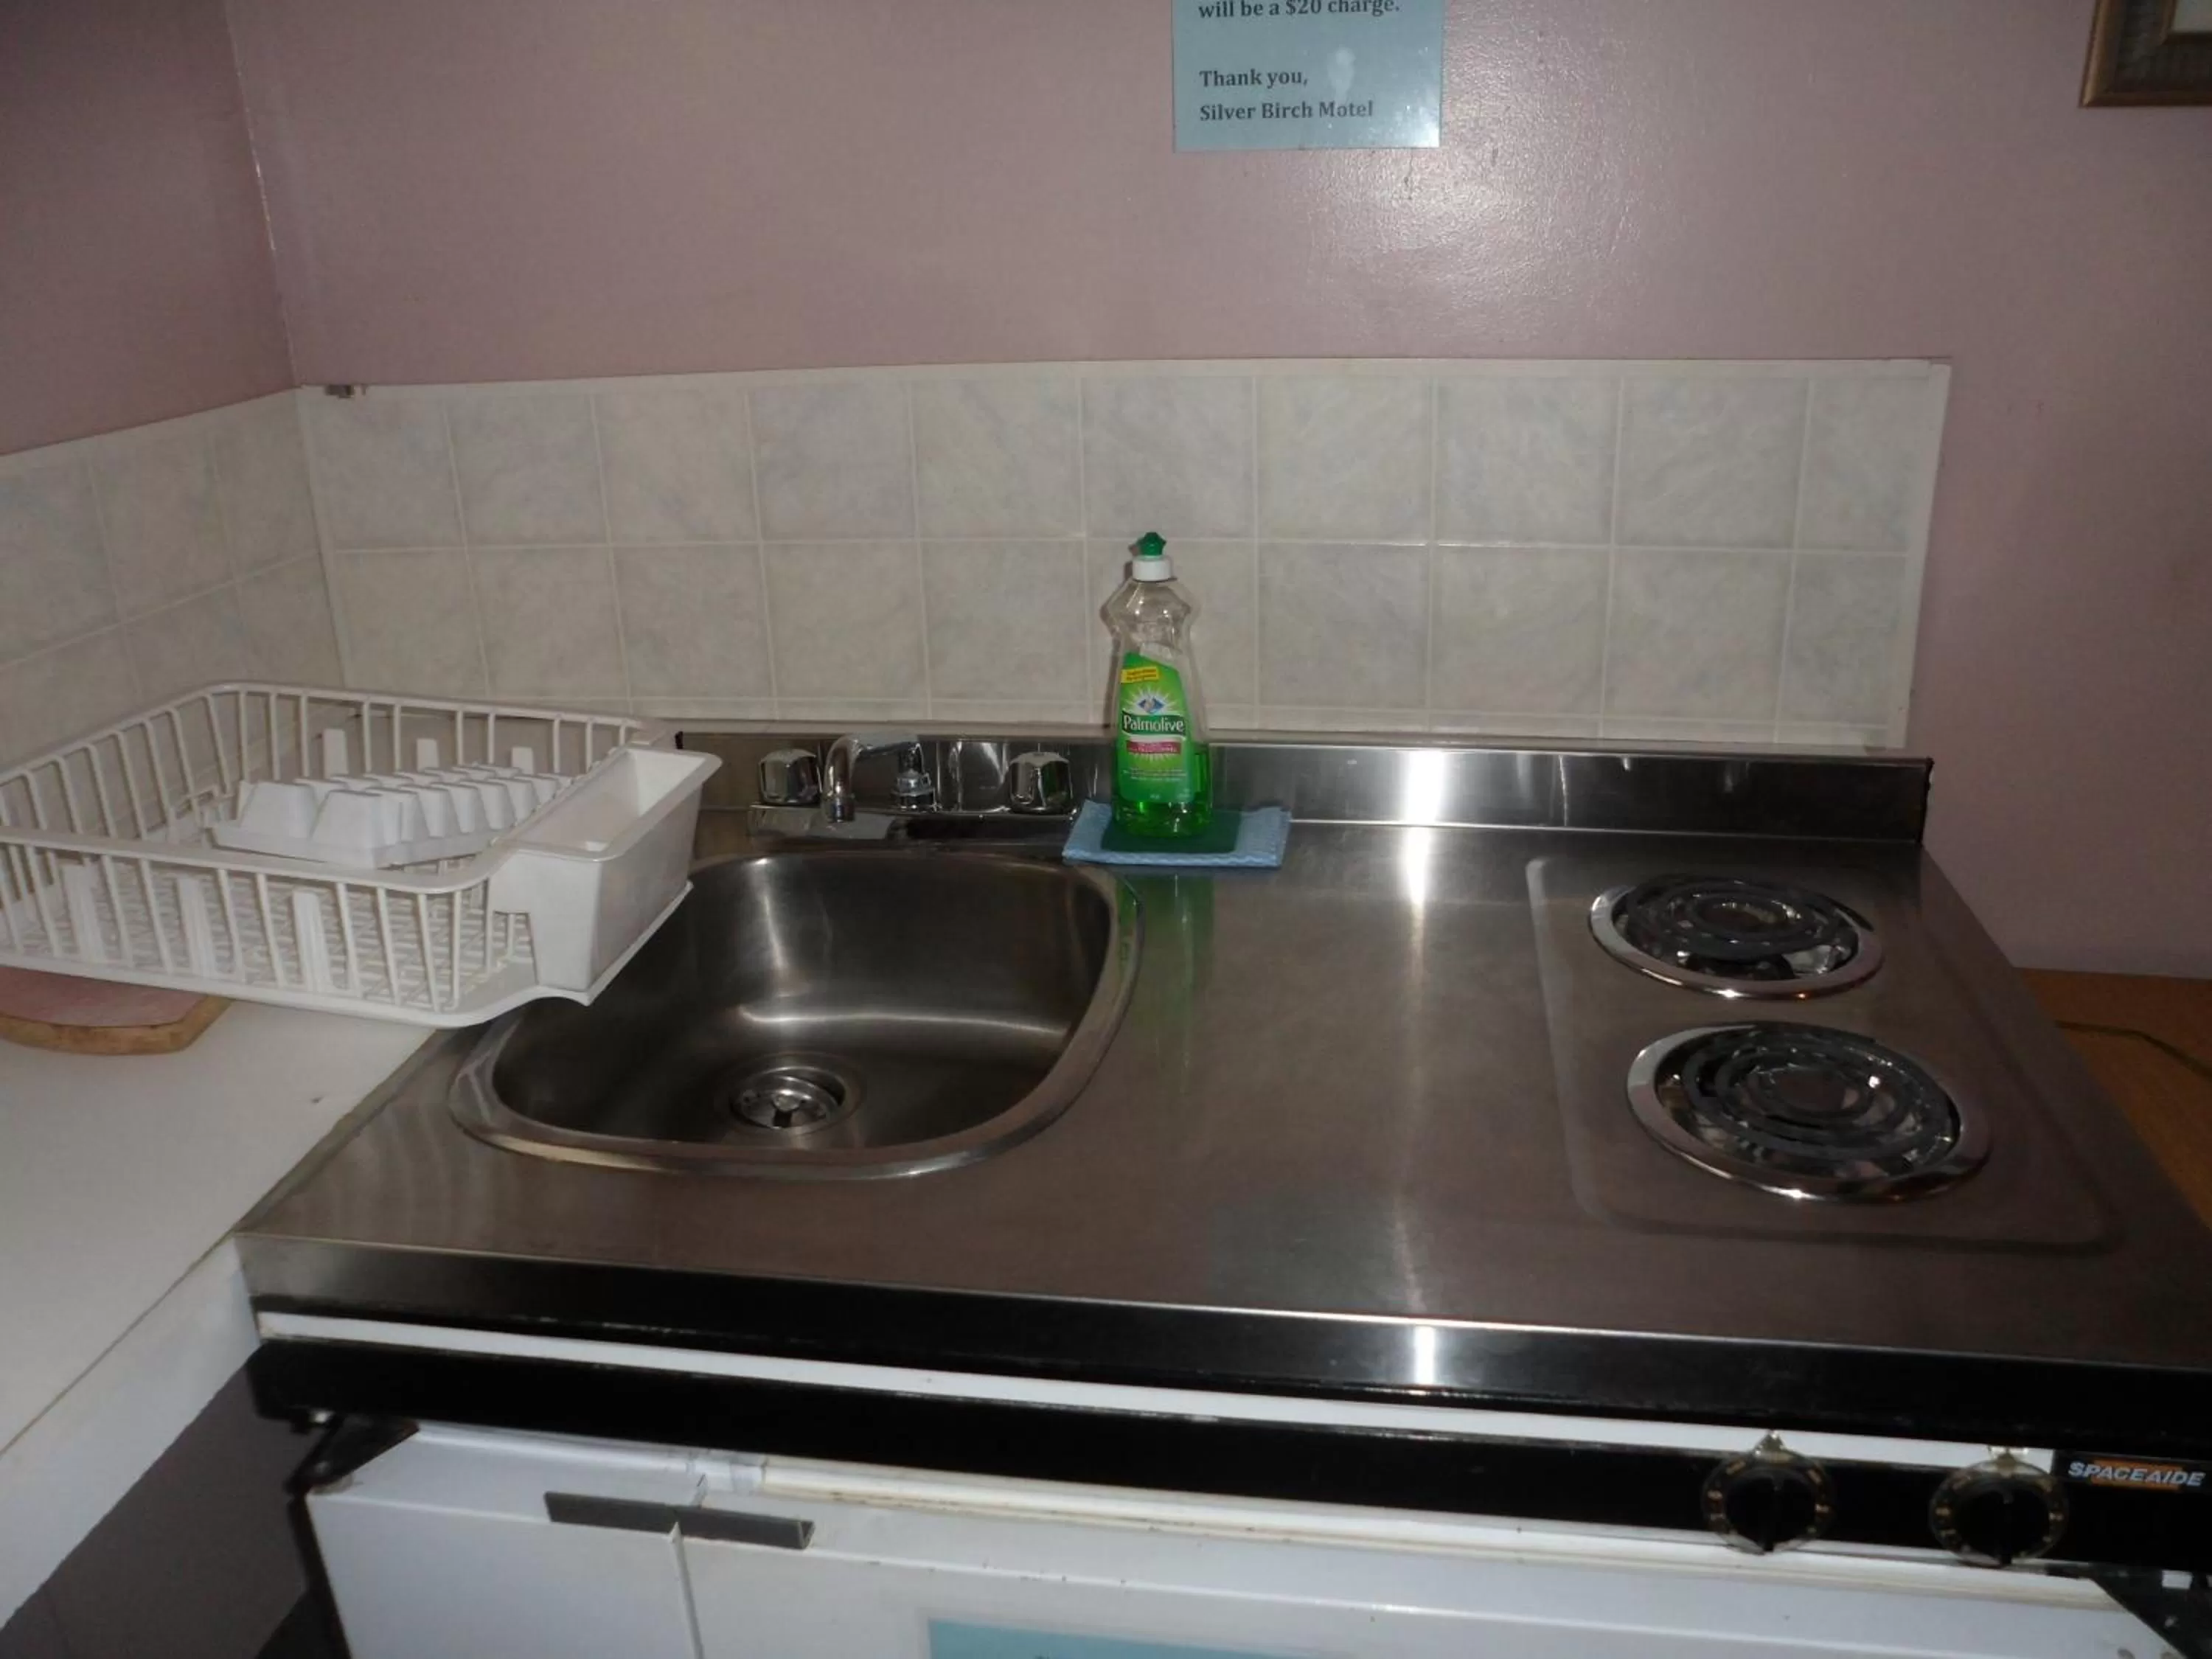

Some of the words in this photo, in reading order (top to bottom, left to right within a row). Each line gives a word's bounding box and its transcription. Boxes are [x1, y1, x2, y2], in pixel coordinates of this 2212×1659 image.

[1198, 0, 1234, 18] will
[1240, 0, 1263, 17] be
[1268, 2, 1280, 15] a
[1285, 0, 1322, 15] $20
[1327, 0, 1400, 17] charge.
[1199, 69, 1262, 88] Thank
[1265, 72, 1308, 88] you,
[1199, 102, 1256, 122] Silver
[1262, 100, 1313, 119] Birch
[1318, 100, 1374, 119] Motel
[1123, 714, 1185, 732] Palmolive
[2068, 1461, 2206, 1486] SPACEAIDE
